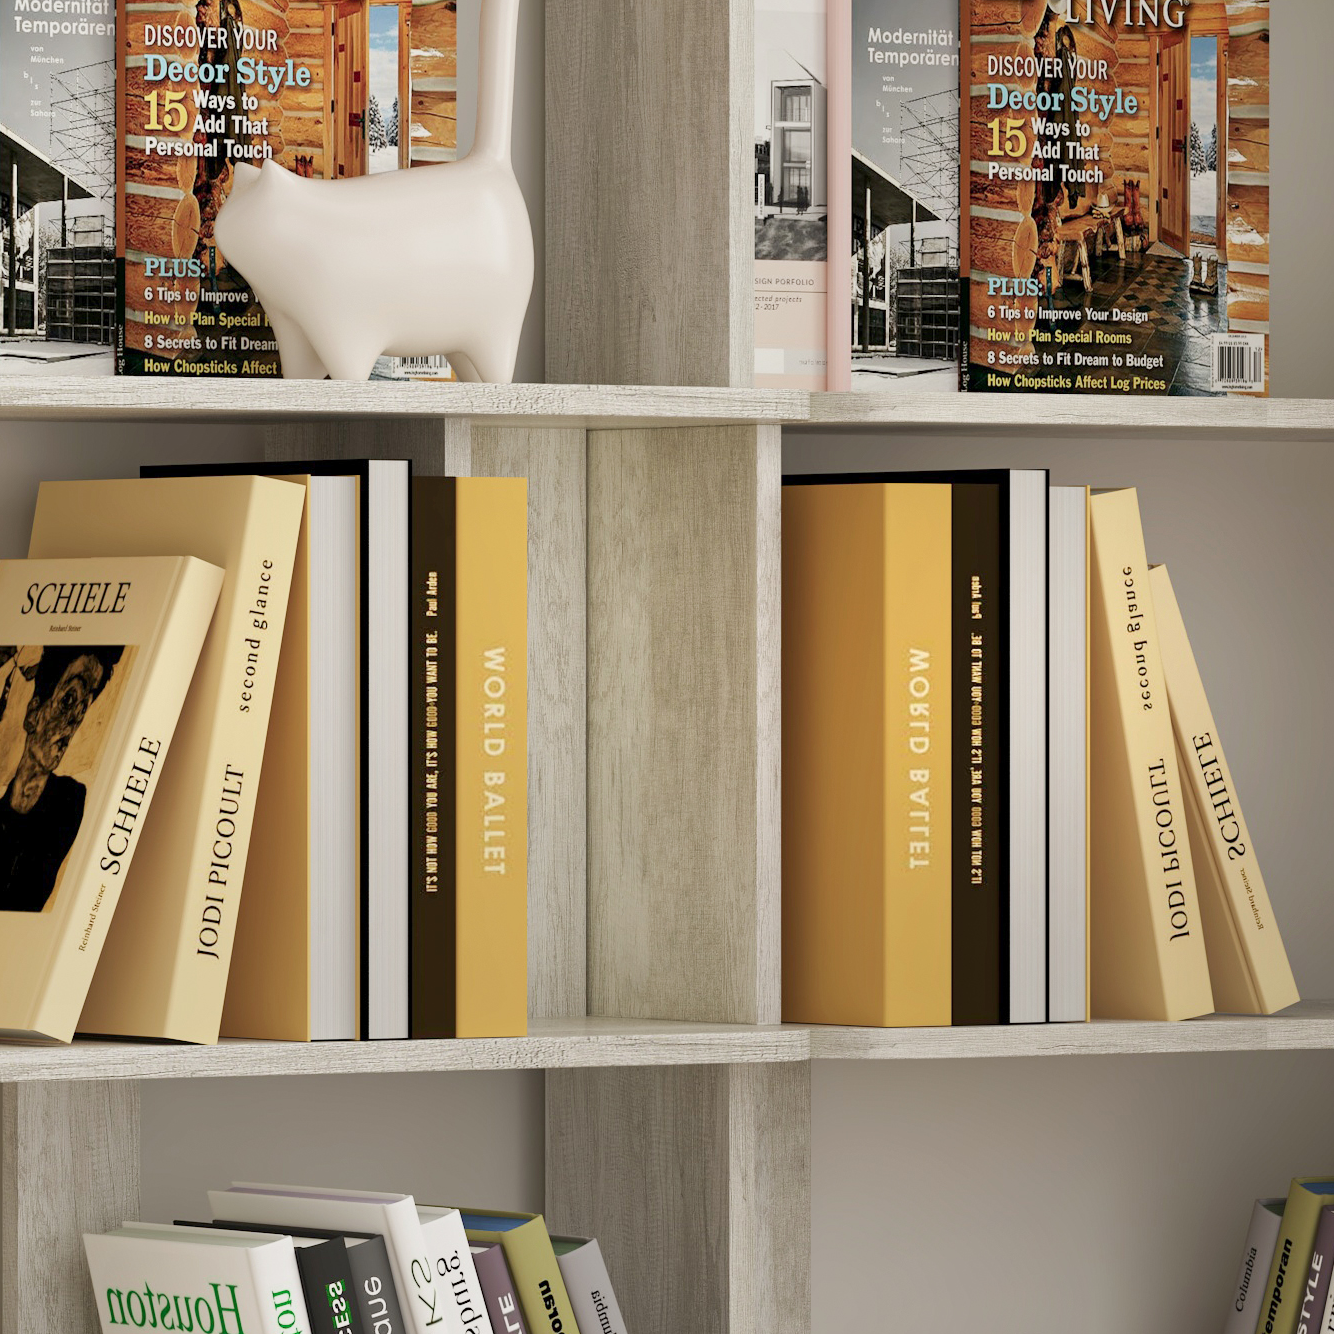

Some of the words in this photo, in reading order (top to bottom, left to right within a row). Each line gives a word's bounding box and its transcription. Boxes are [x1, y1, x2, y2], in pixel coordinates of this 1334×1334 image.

[144, 24, 228, 49] DISCOVER
[233, 27, 278, 51] YOUR
[143, 54, 230, 84] Decor
[236, 57, 311, 94] Style
[143, 89, 188, 132] 15
[193, 89, 236, 111] Ways
[242, 92, 258, 111] to
[193, 114, 226, 134] Add
[232, 115, 268, 135] That
[145, 136, 218, 158] Personal
[224, 139, 273, 159] Touch
[144, 257, 206, 278] PLUS:
[987, 307, 996, 320] 6
[999, 305, 1022, 321] Tips
[1024, 307, 1035, 320] to
[1038, 307, 1082, 322] Improve
[1085, 308, 1110, 321] Your
[1112, 309, 1149, 323] Design
[987, 328, 1011, 342] How
[1014, 330, 1026, 342] to
[1028, 330, 1052, 343] Plan
[1055, 331, 1093, 345] Special
[1095, 332, 1132, 344] Rooms
[987, 352, 996, 365] 8
[998, 352, 1039, 366] Secrets
[1042, 353, 1054, 365] to
[1057, 353, 1072, 366] Fit
[1074, 354, 1109, 367] Dream
[1112, 354, 1123, 367] to
[1126, 355, 1164, 370] Budget
[987, 374, 1011, 388] How
[1014, 375, 1072, 391] Chopsticks
[1074, 376, 1108, 389] Affect
[1110, 377, 1130, 392] Log
[1133, 378, 1166, 390] Prices
[21, 582, 131, 615] SCHIELE
[249, 559, 273, 629] glance
[239, 638, 261, 713] second
[483, 647, 506, 757] WORLD
[100, 736, 162, 876] SCHIELE
[483, 771, 506, 875] BALLET
[208, 764, 244, 888] PICOULT
[197, 896, 225, 959] JODI
[1235, 1247, 1258, 1313] Columbia
